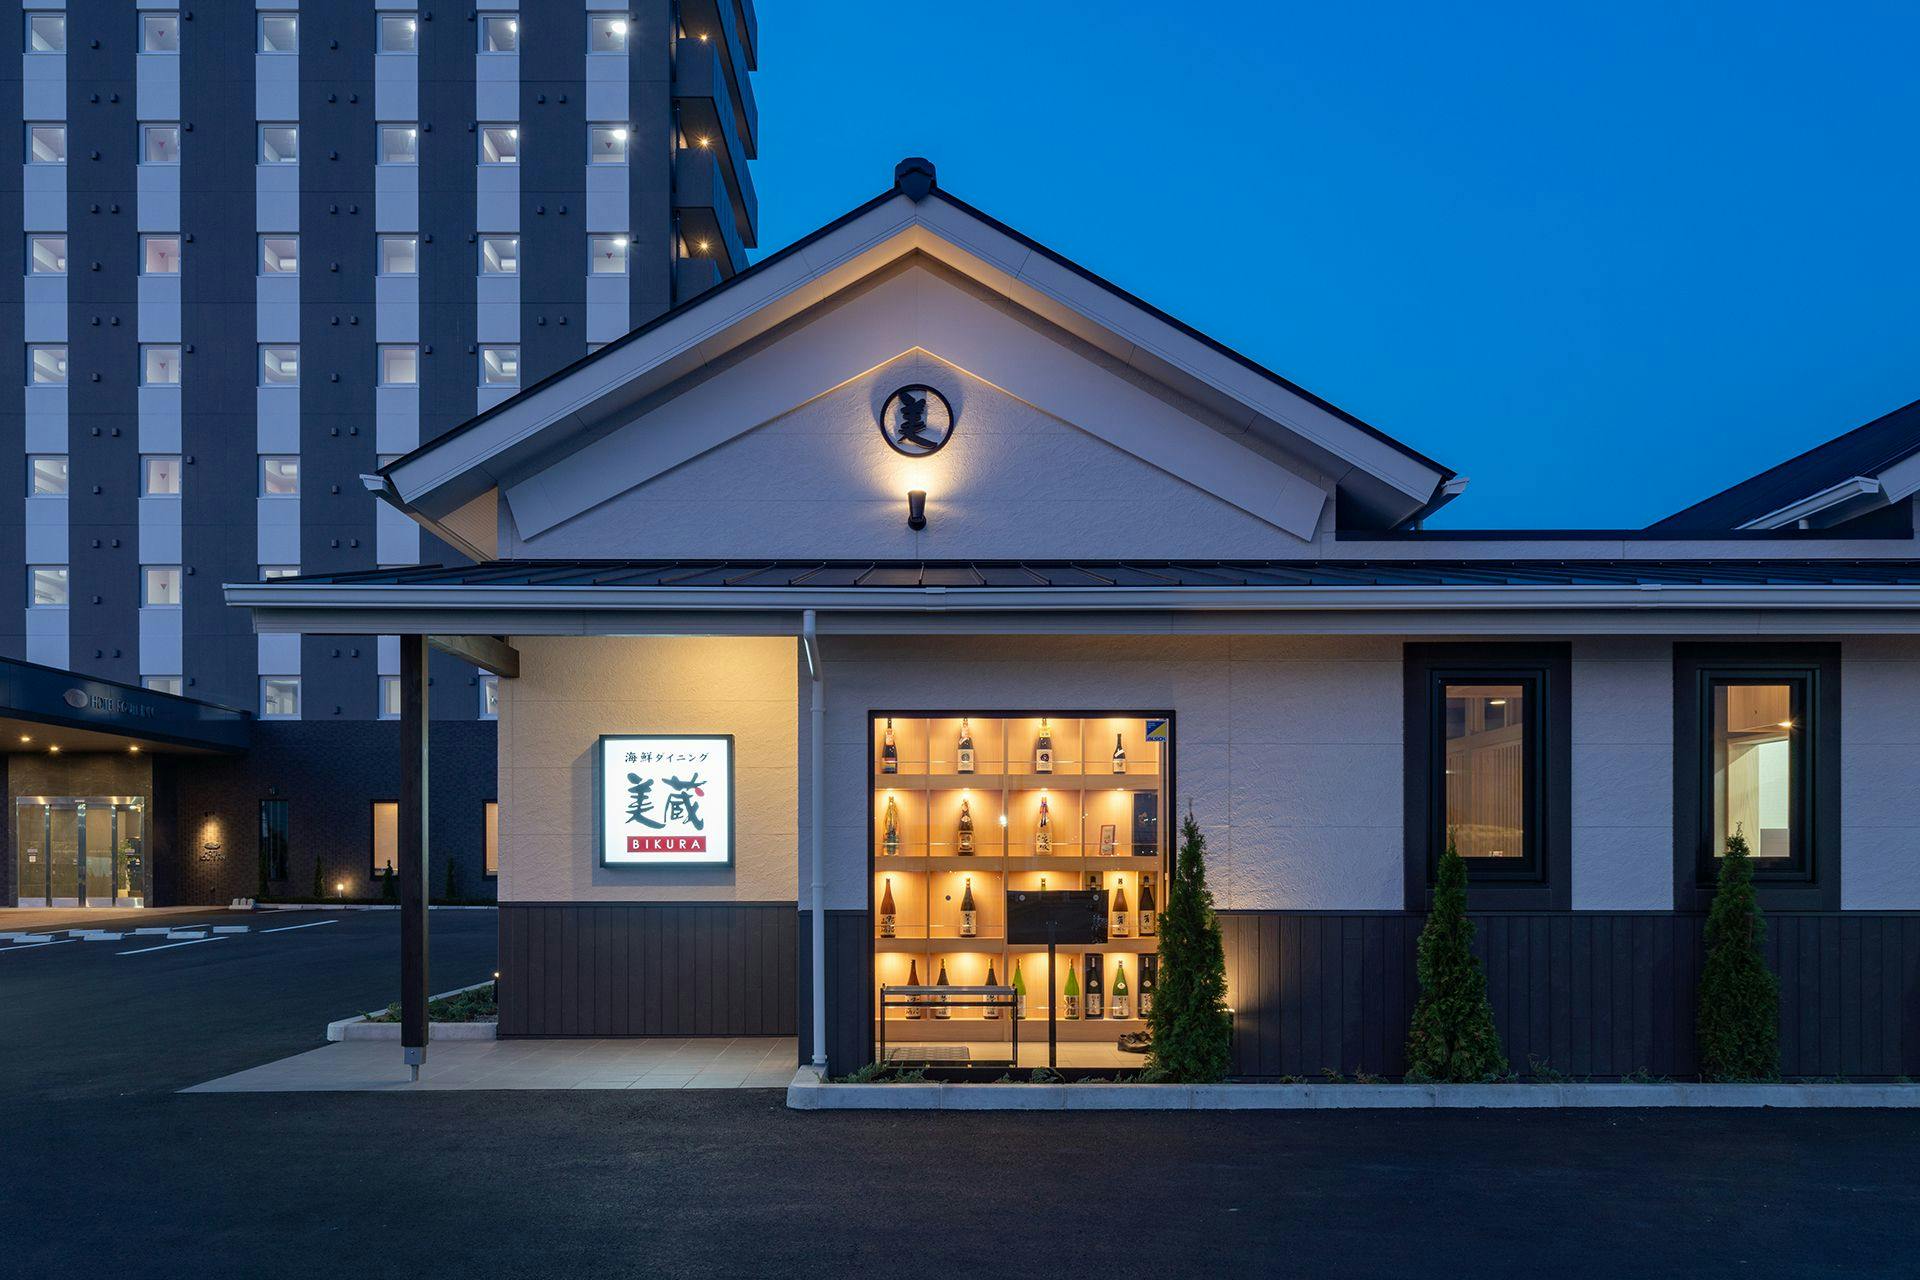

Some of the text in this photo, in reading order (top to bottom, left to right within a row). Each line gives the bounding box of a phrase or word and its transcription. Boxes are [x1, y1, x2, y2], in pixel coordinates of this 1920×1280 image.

[625, 751, 709, 763] 海鮮ダイニング
[625, 772, 708, 831] 美蔵
[632, 839, 701, 850] BIKURA
